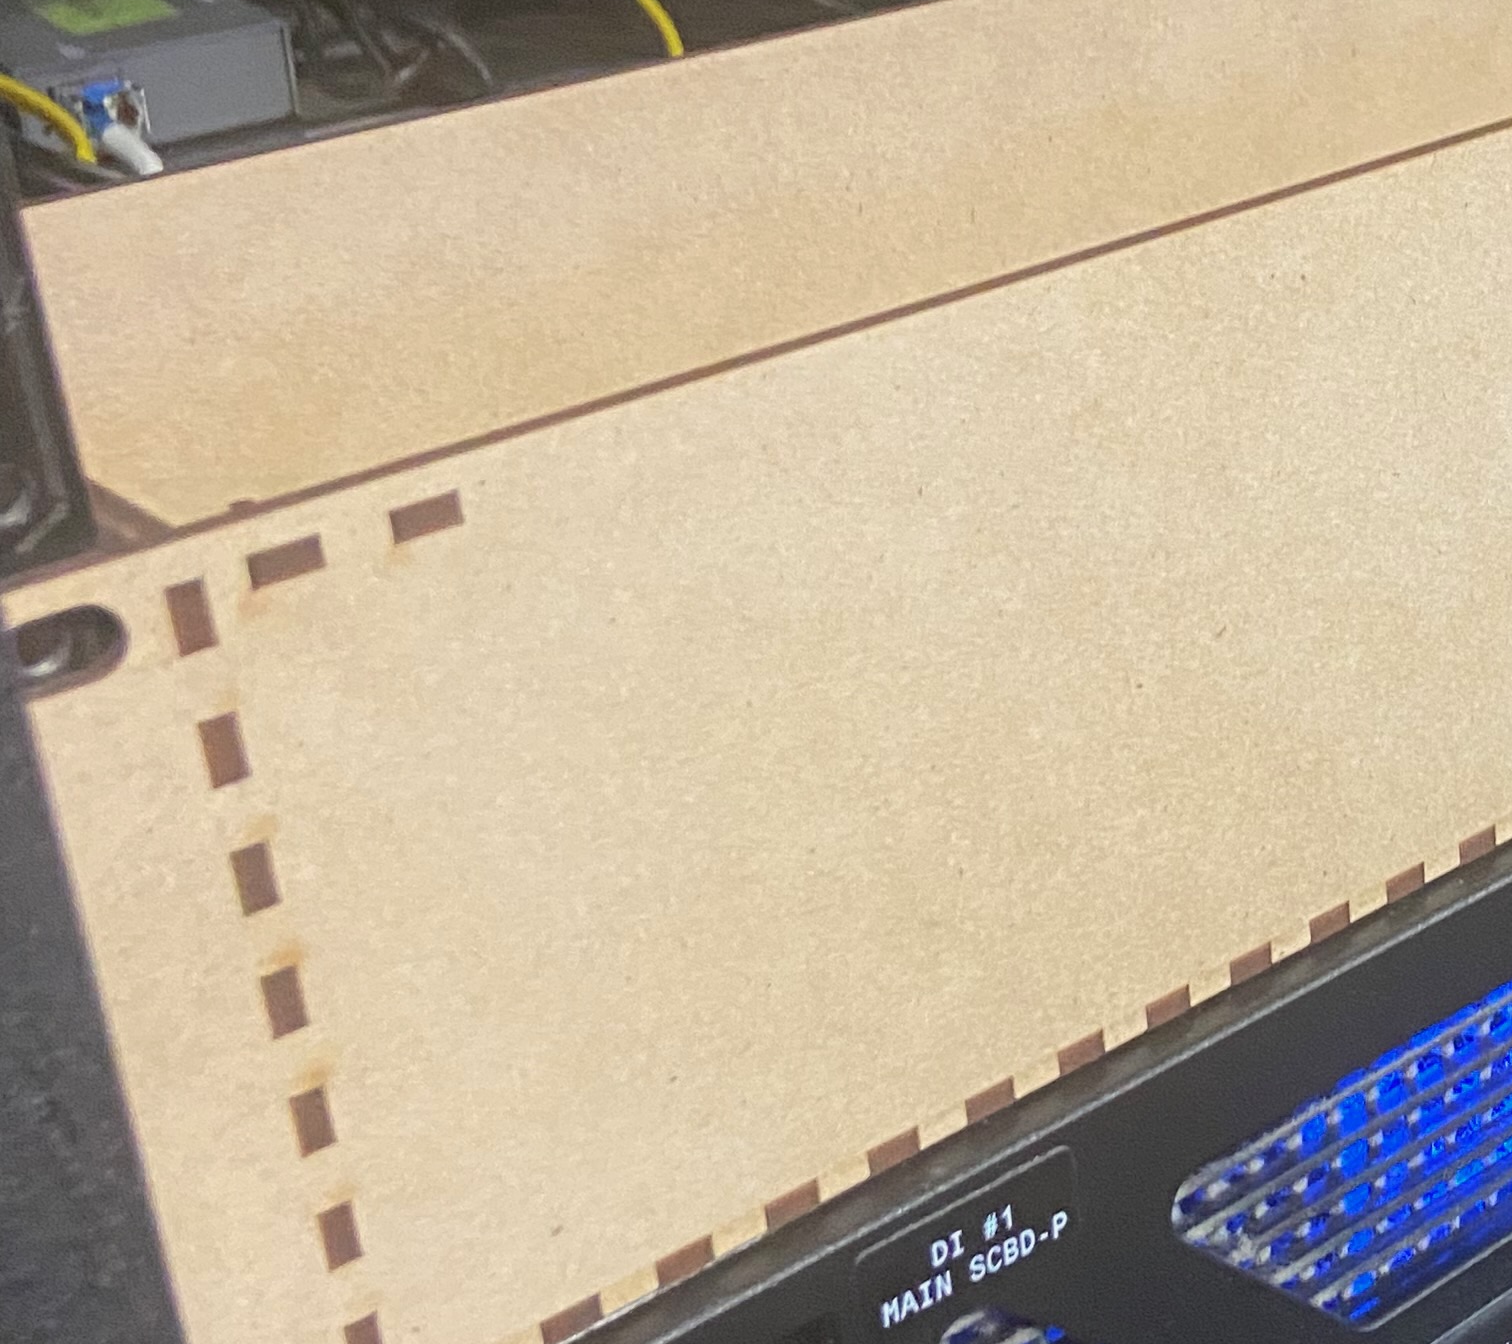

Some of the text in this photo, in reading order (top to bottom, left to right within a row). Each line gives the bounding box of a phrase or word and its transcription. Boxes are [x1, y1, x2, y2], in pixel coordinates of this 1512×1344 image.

[880, 1210, 1069, 1328] MAIN SCBD-P
[931, 1204, 1014, 1268] DI #1
